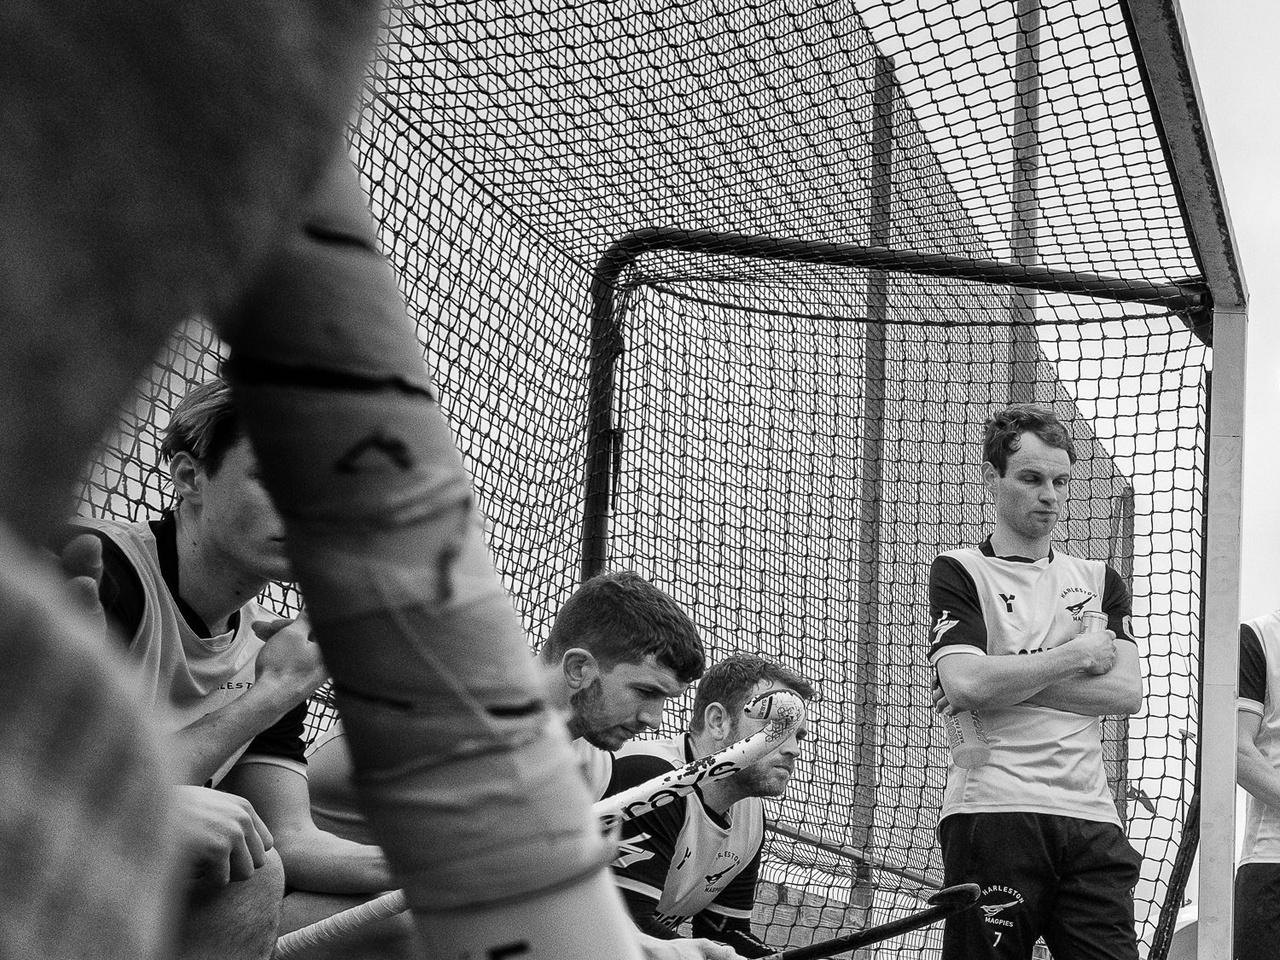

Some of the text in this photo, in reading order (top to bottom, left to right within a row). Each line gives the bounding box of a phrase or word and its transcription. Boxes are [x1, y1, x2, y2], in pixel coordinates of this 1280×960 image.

[982, 884, 1025, 904] HARLESTON
[984, 916, 1014, 928] MAGPIES
[992, 931, 1003, 947] 7
